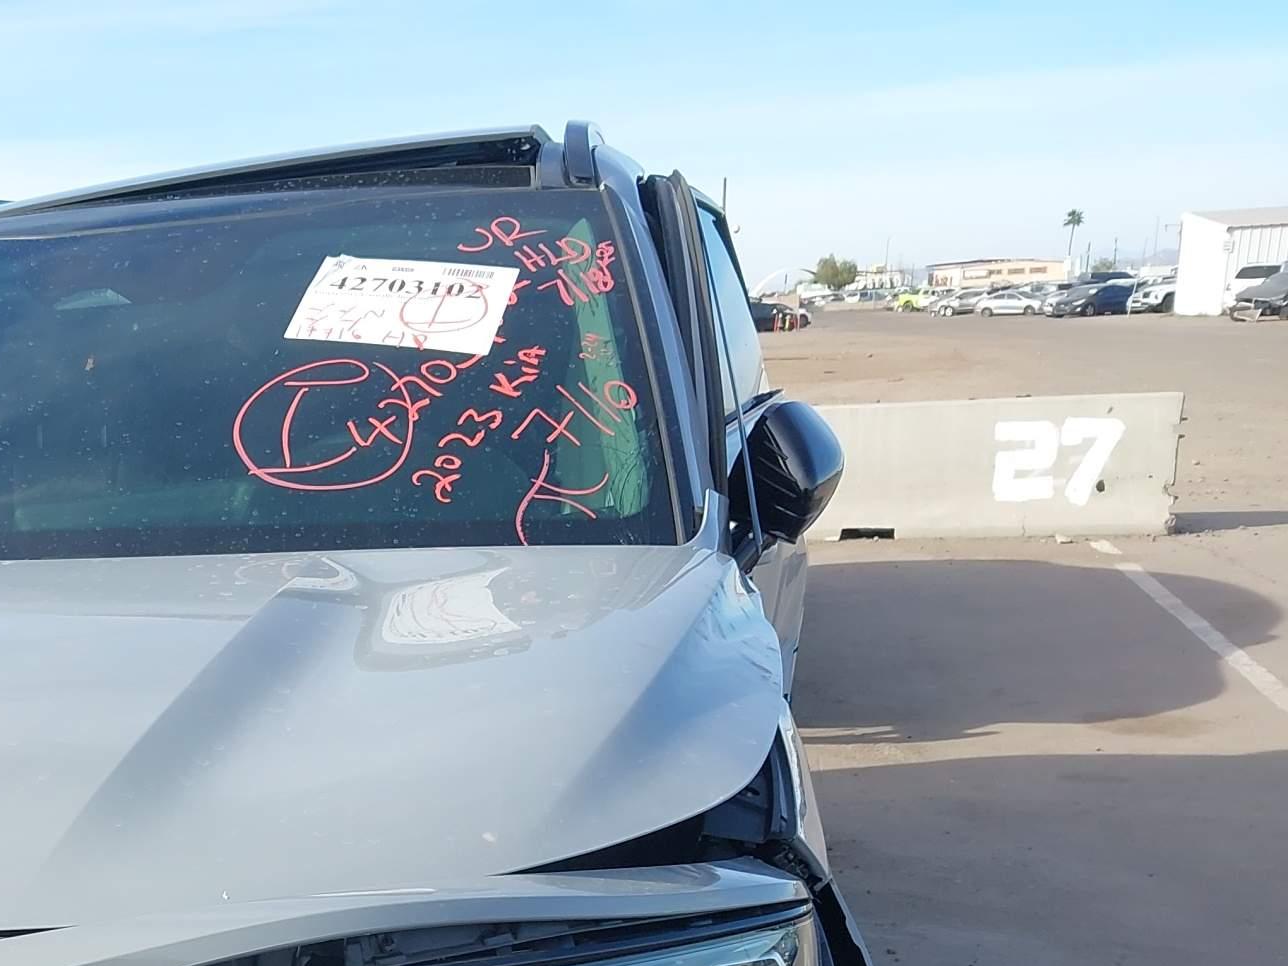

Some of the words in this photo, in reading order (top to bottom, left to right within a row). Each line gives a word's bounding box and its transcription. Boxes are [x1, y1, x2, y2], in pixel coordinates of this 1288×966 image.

[329, 276, 483, 300] 42703102
[411, 408, 503, 503] 2023
[991, 416, 1127, 506] 27
